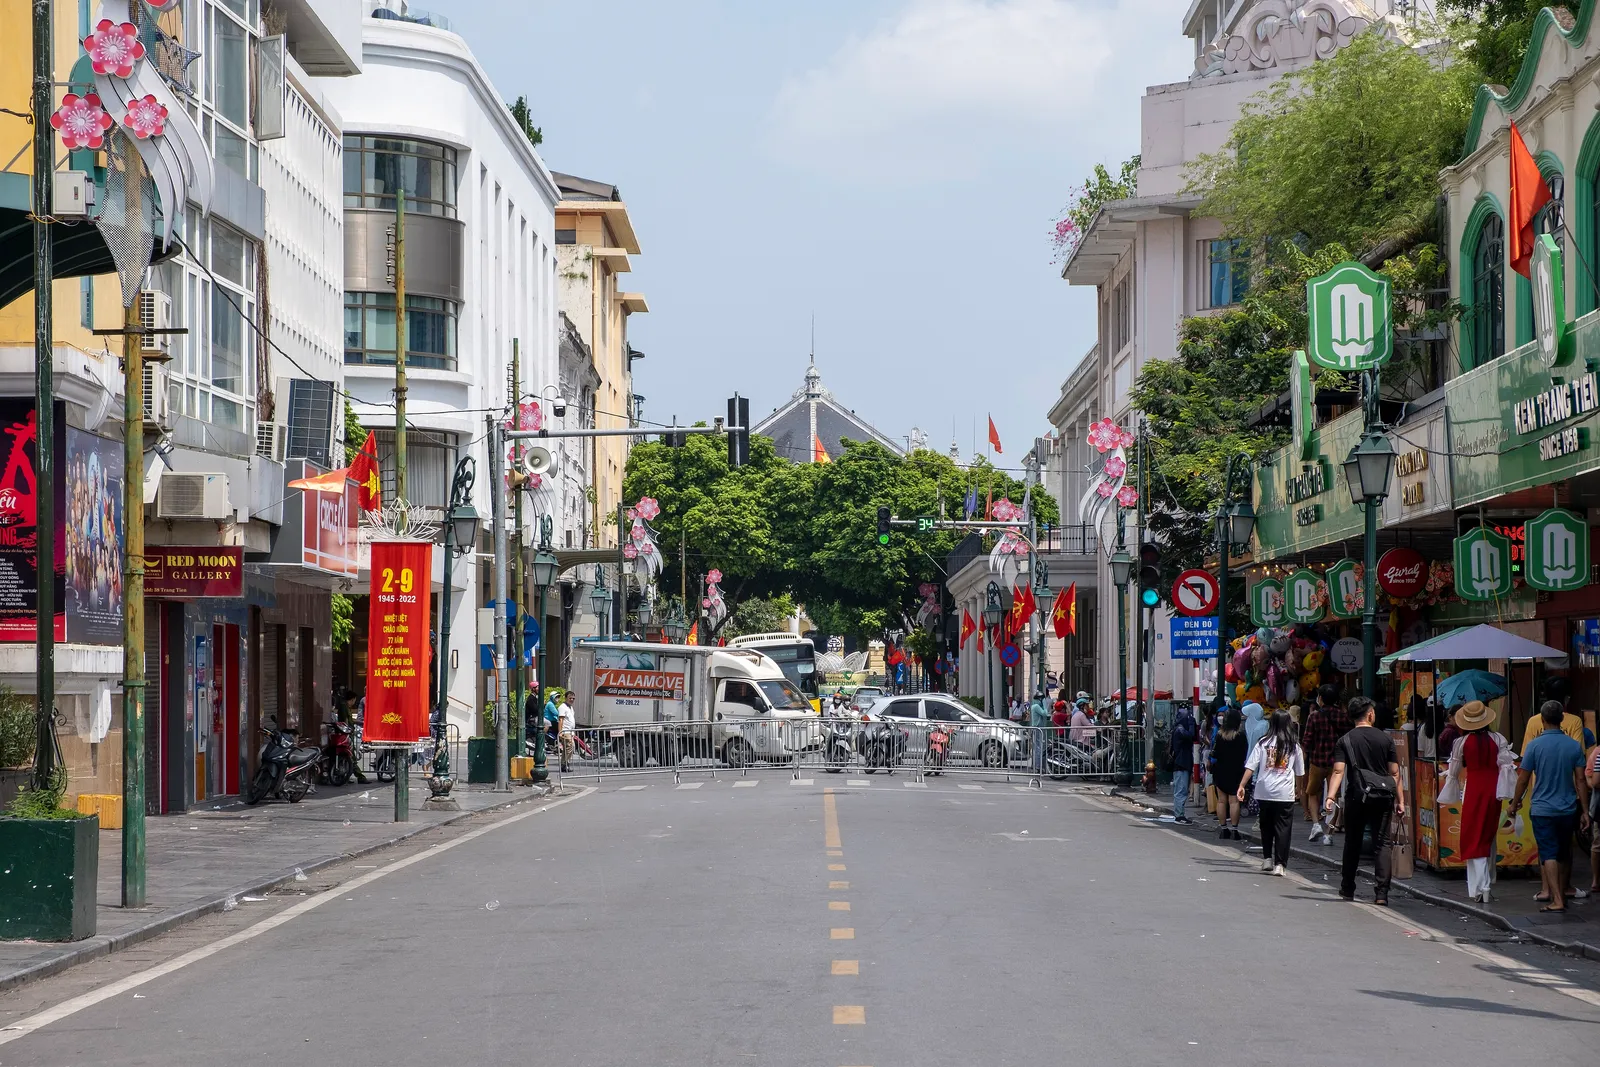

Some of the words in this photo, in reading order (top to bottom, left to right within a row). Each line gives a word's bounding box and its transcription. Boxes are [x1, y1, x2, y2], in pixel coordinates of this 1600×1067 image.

[1514, 396, 1537, 436] KEM
[1540, 433, 1562, 461] SINCE
[918, 518, 933, 531] 34
[167, 556, 195, 566] RED
[198, 556, 236, 567] MOON
[172, 571, 232, 580] GALLERY
[382, 568, 413, 592] 2-9
[1184, 619, 1199, 628] ĐÈN
[1202, 618, 1212, 628] ĐỎ
[1187, 638, 1202, 646] CHÚ
[1205, 638, 1210, 646] Ý
[609, 673, 684, 689] LALAMOVE
